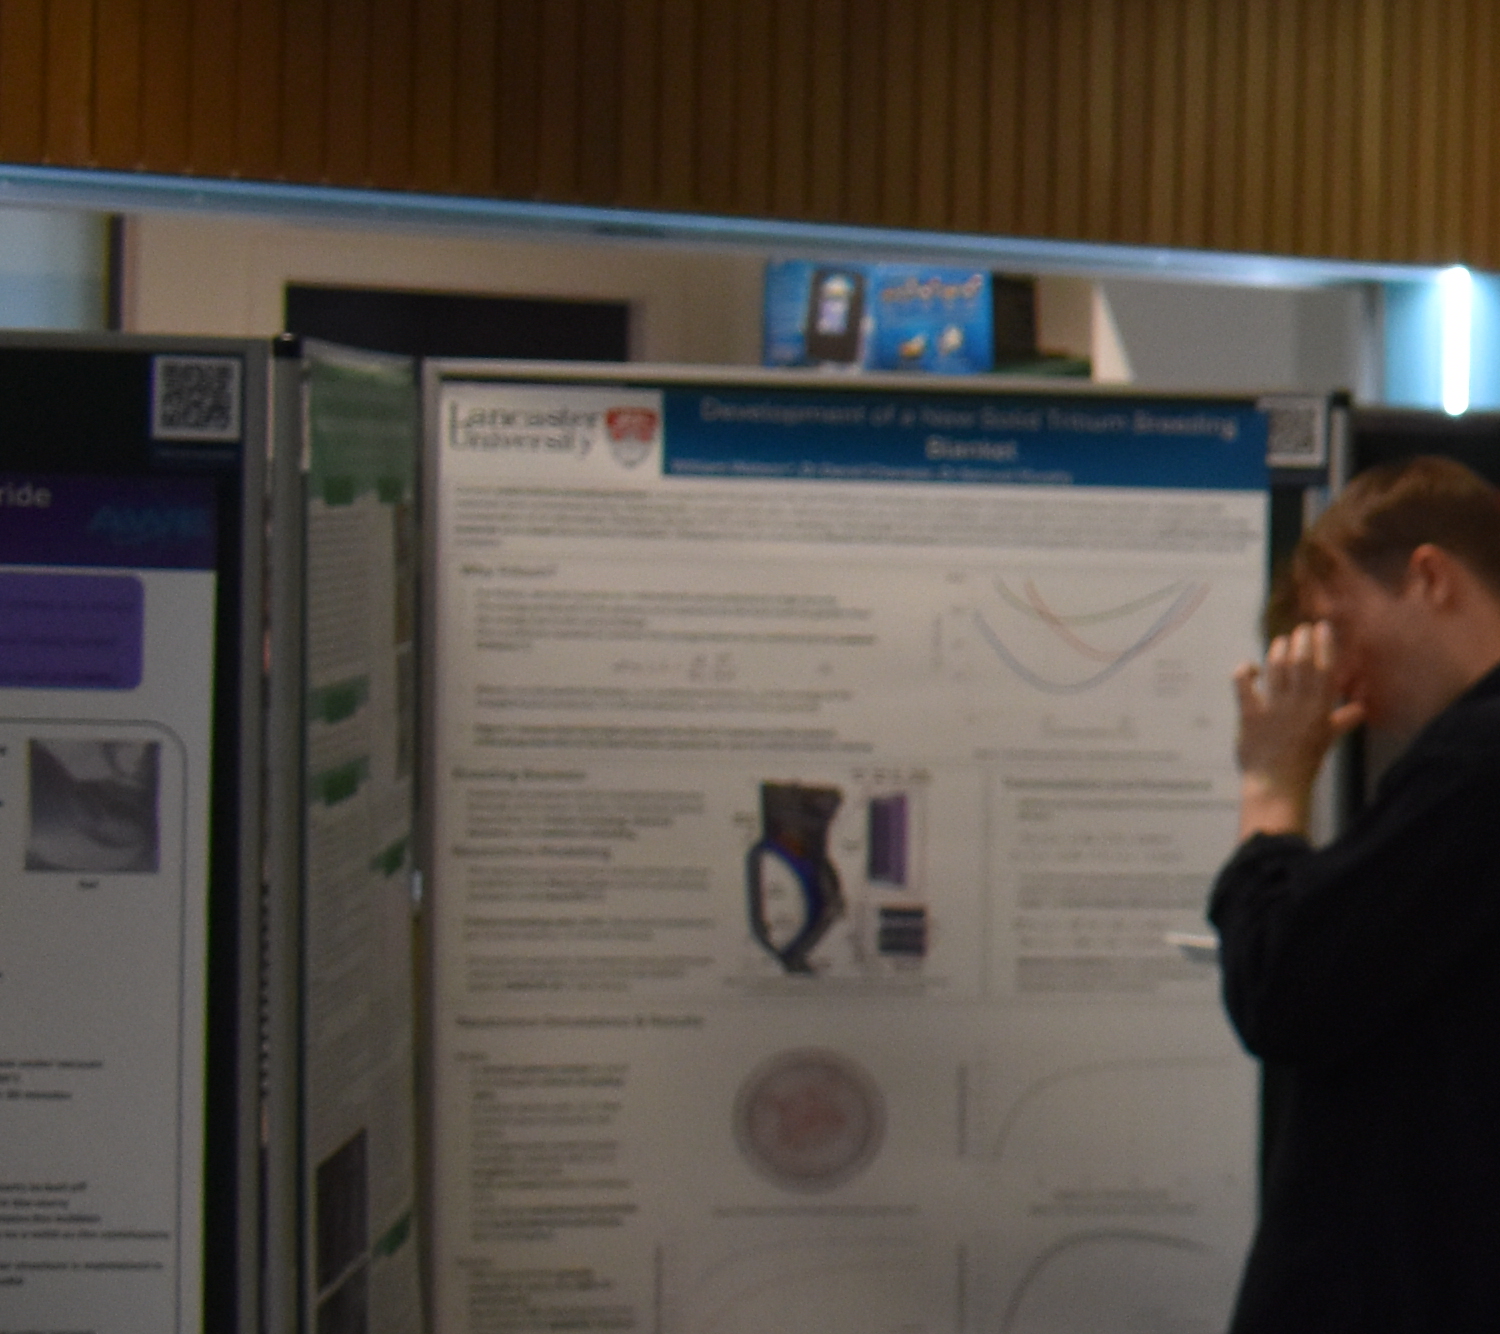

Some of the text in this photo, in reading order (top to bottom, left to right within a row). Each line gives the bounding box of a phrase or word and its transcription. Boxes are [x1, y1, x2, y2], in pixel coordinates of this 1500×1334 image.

[449, 401, 602, 427] Lancaster
[700, 398, 1238, 440] Development of a New Solid Tritium Breeding
[449, 428, 592, 458] University
[926, 436, 1018, 461] Blanket
